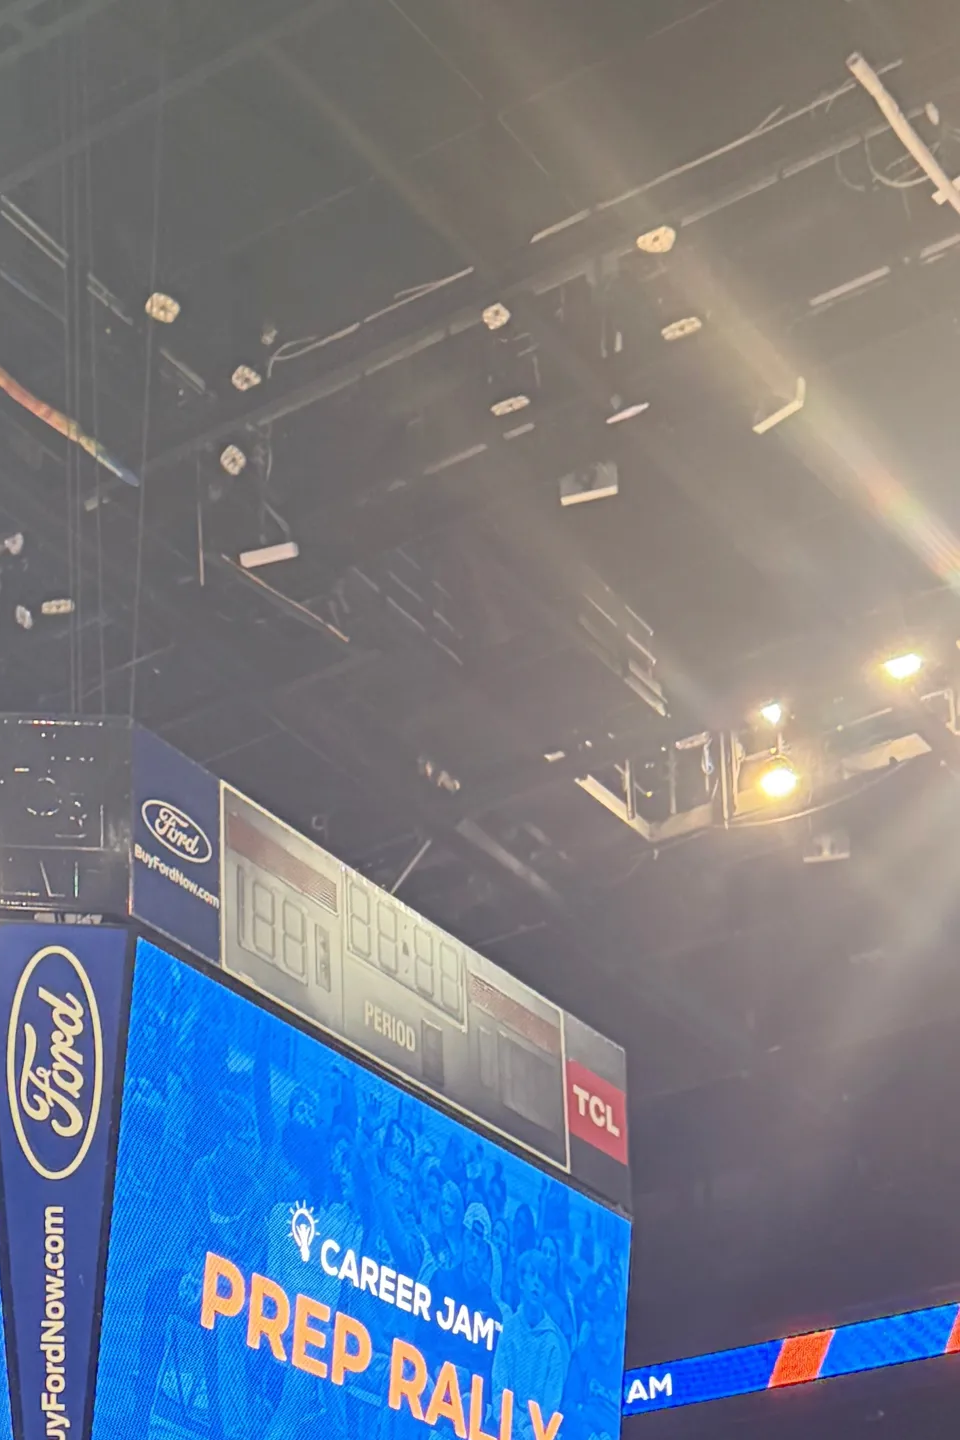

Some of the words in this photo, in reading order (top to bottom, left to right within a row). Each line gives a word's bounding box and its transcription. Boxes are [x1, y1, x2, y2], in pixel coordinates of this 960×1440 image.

[154, 807, 200, 855] Ford
[134, 843, 220, 909] BuyFordNow.com
[364, 1000, 416, 1052] PERIOD
[20, 986, 84, 1138] Ford
[572, 1084, 621, 1137] TCL
[320, 1239, 431, 1321] CAREER
[200, 1251, 372, 1386] PREP
